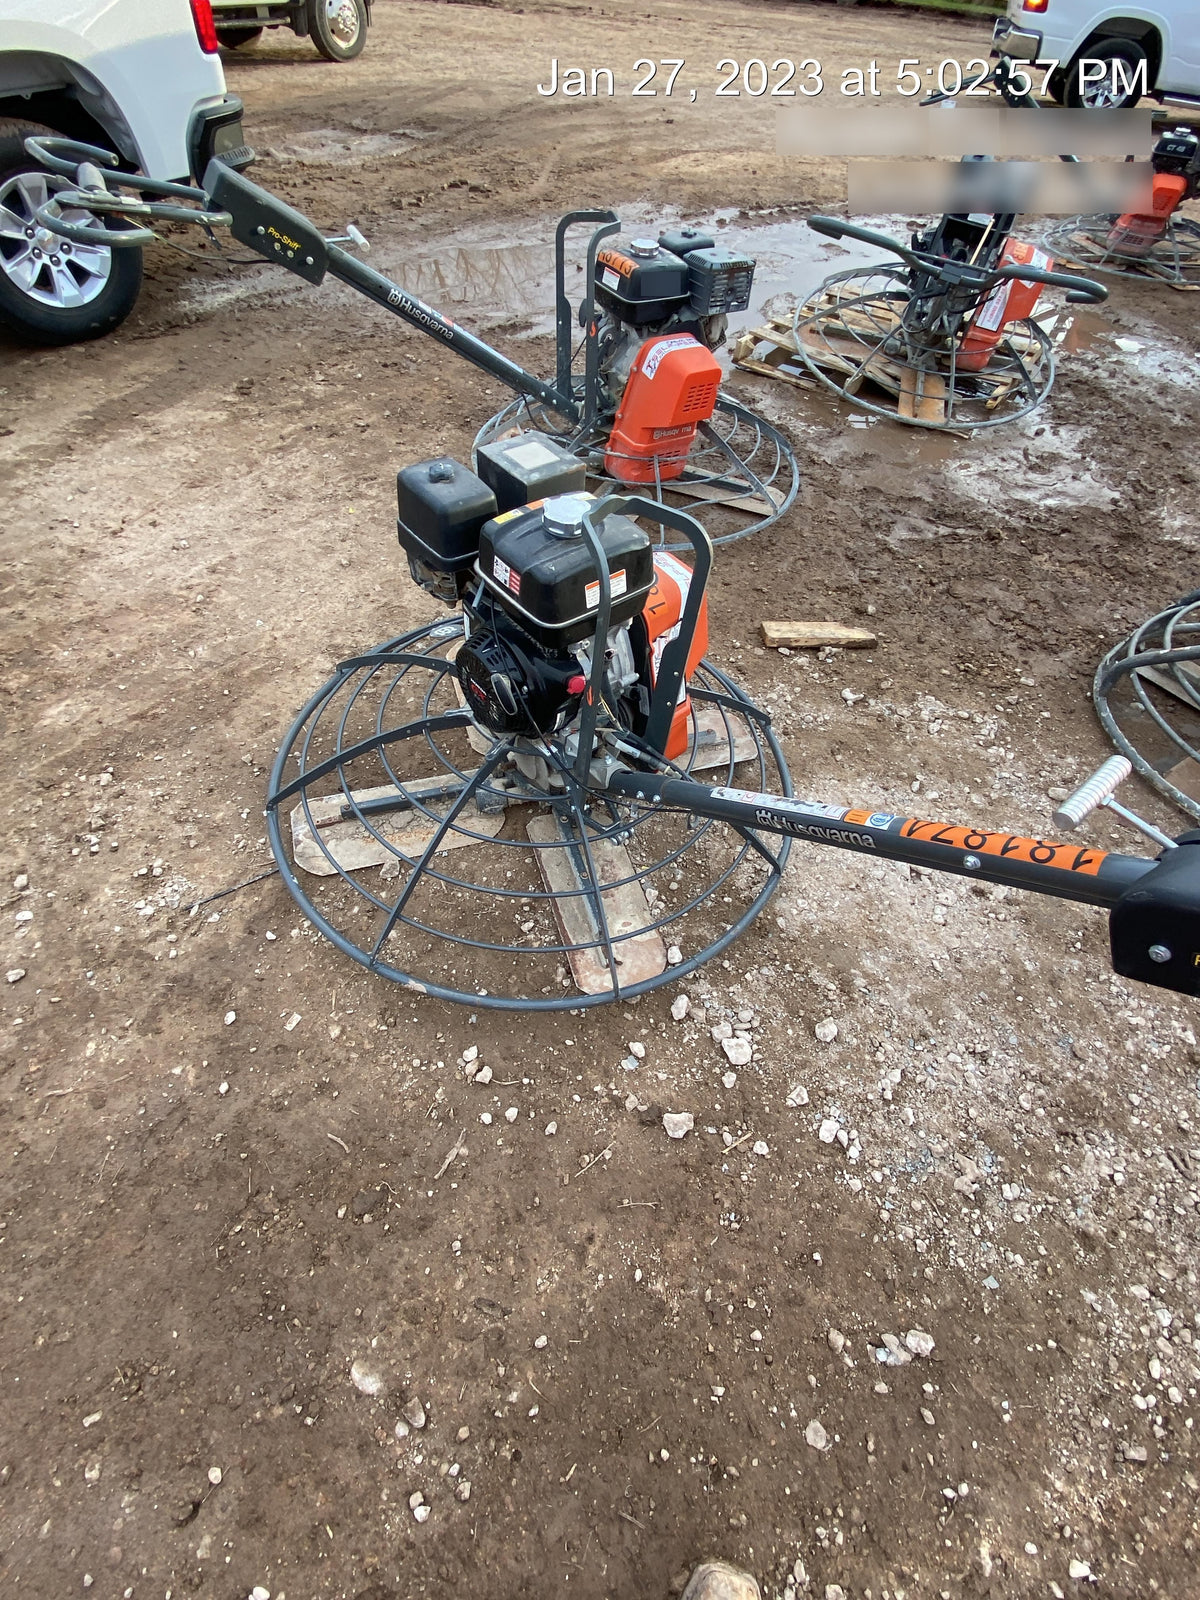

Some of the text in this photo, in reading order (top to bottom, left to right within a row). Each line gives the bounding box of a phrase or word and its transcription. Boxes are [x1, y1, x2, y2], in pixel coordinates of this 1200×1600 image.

[267, 226, 301, 251] Pro-Shift
[400, 297, 454, 340] Husqvarna
[774, 814, 877, 849] Husqvarna
